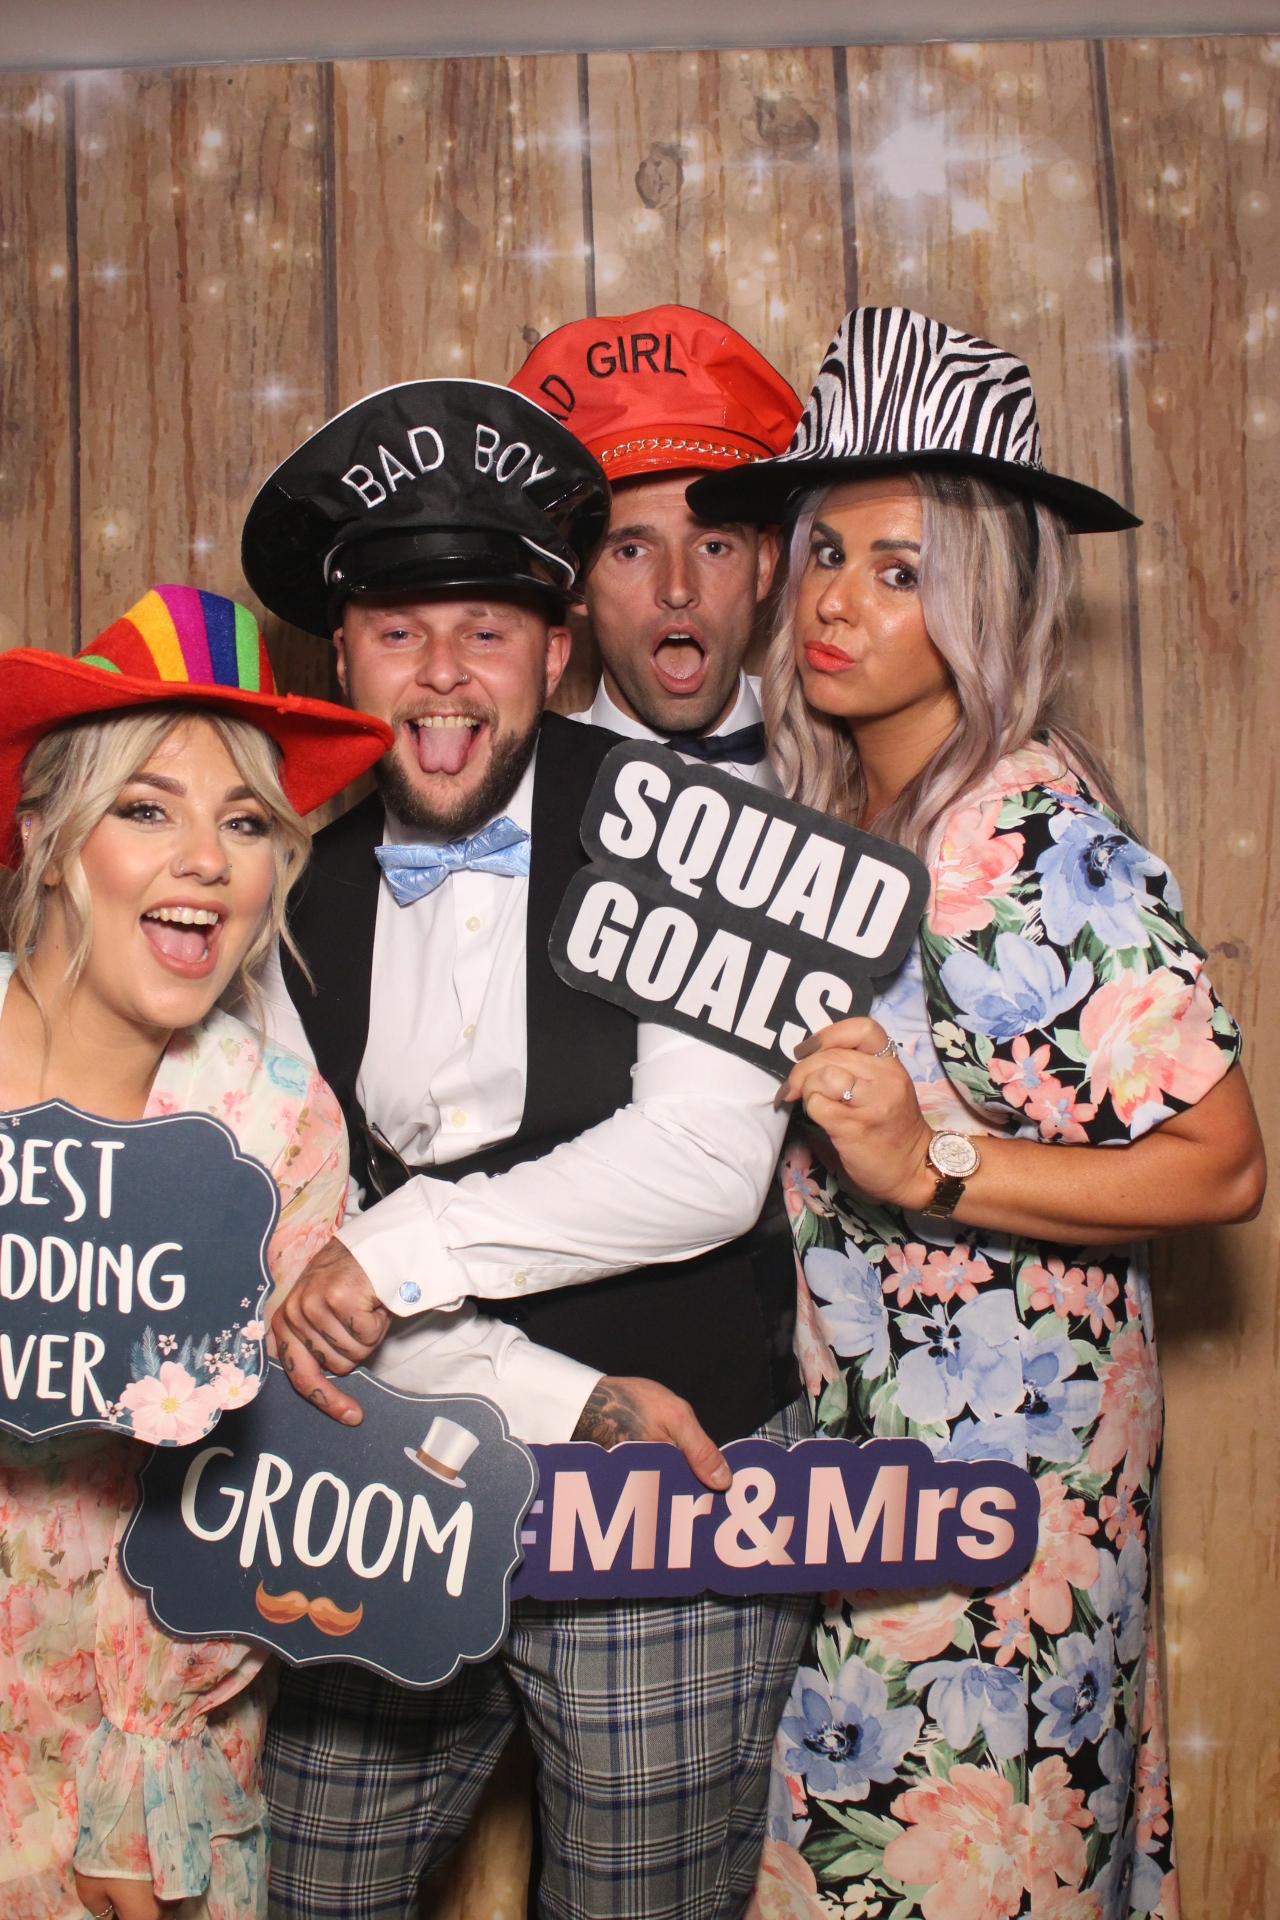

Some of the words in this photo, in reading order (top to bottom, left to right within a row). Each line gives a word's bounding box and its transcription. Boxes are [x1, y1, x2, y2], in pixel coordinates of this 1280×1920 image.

[539, 374, 576, 421] D
[586, 333, 687, 378] GIRL
[341, 425, 445, 508] BAD
[474, 423, 557, 489] BOY
[599, 760, 911, 959] SQUAD
[566, 881, 853, 1063] GOALS
[0, 1133, 125, 1222] BEST
[0, 1233, 186, 1314] DDING
[0, 1331, 107, 1417] VER
[181, 1446, 474, 1597] GROOM
